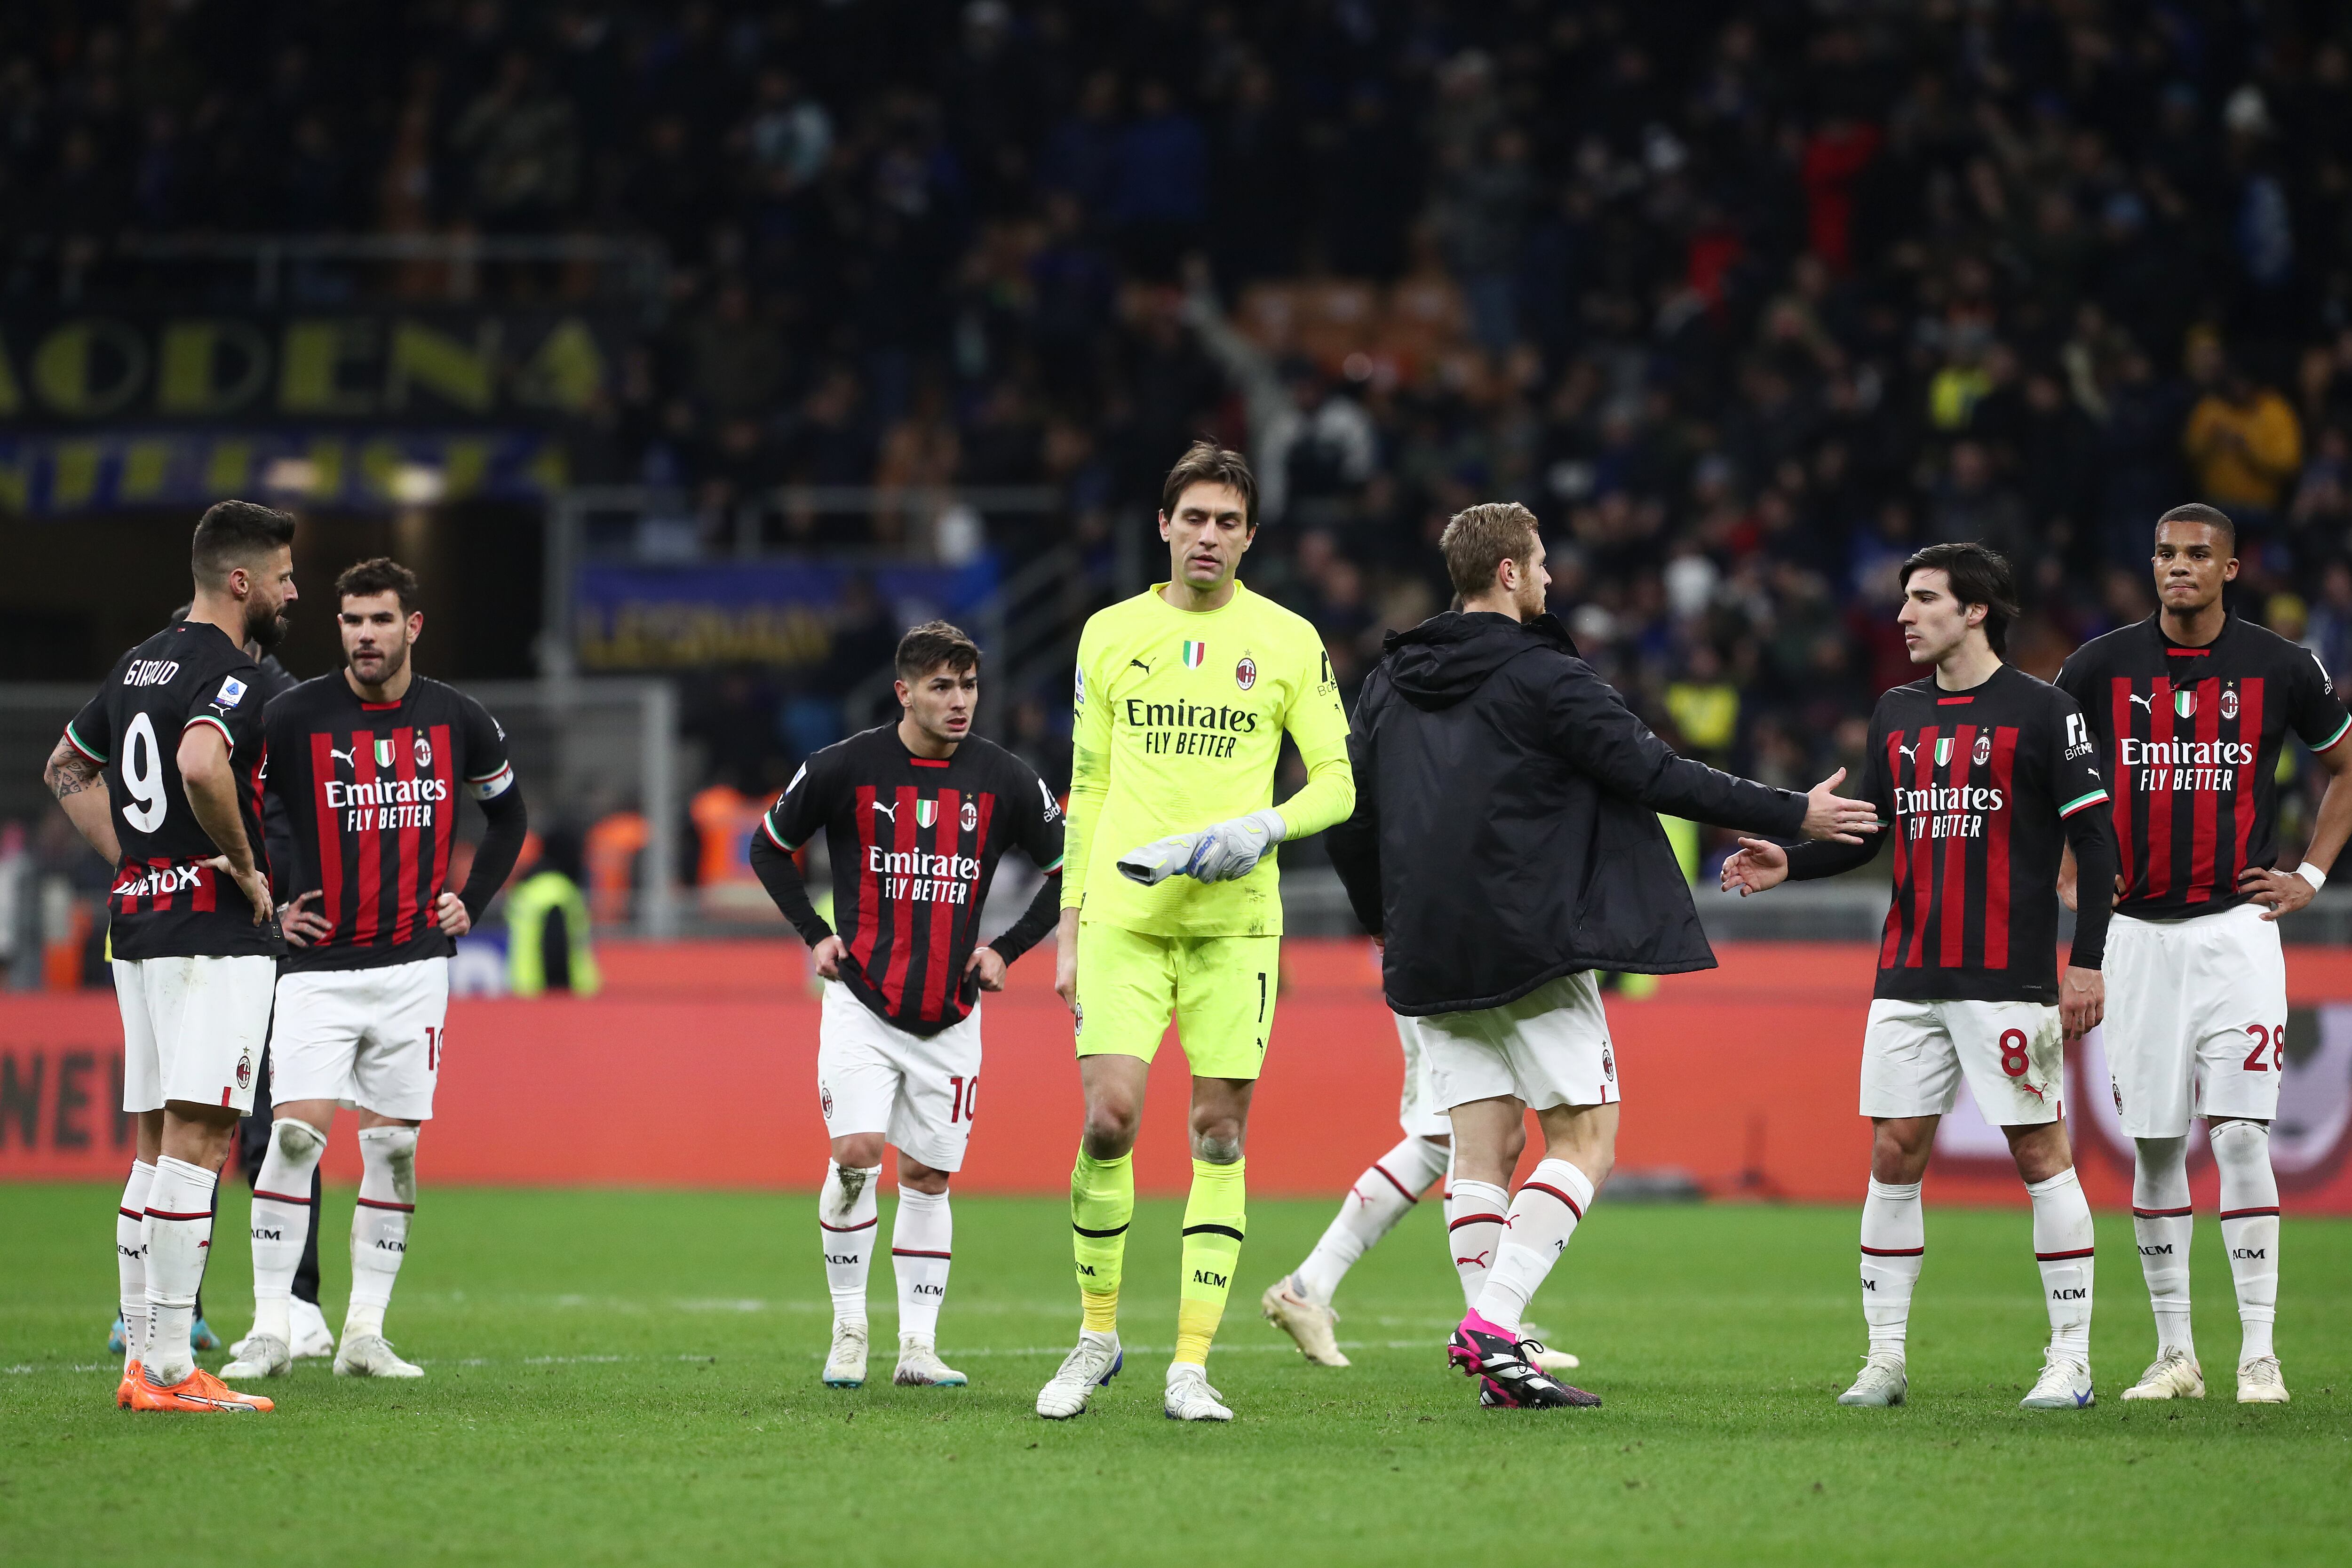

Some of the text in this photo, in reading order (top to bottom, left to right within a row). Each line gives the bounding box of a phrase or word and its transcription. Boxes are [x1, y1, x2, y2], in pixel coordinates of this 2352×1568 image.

[0, 315, 604, 418] ODENA
[1126, 699, 1257, 732] Emirates
[1146, 732, 1236, 758] FLY BETTER
[2120, 736, 2253, 765] Emirates
[121, 712, 167, 834] 9
[2140, 768, 2233, 791] FLY BETTER
[324, 776, 447, 808] Emirates
[1893, 782, 2003, 815] Emirates
[347, 804, 432, 832] FLY BETTER
[1931, 815, 1982, 839] BETTER
[869, 845, 980, 880] Emirates
[885, 876, 967, 905] FLY BETTER
[1257, 972, 1266, 1023] 1
[425, 1027, 443, 1071] 1
[1999, 1028, 2029, 1077] 8
[2243, 1025, 2284, 1072] 28
[950, 1075, 977, 1123] 10
[825, 1254, 859, 1265] ACM
[2137, 1244, 2173, 1256] ACM
[2233, 1248, 2265, 1260] ACM
[914, 1284, 944, 1296] ACM
[1193, 1270, 1227, 1288] ACM
[2052, 1288, 2086, 1300] ACM
